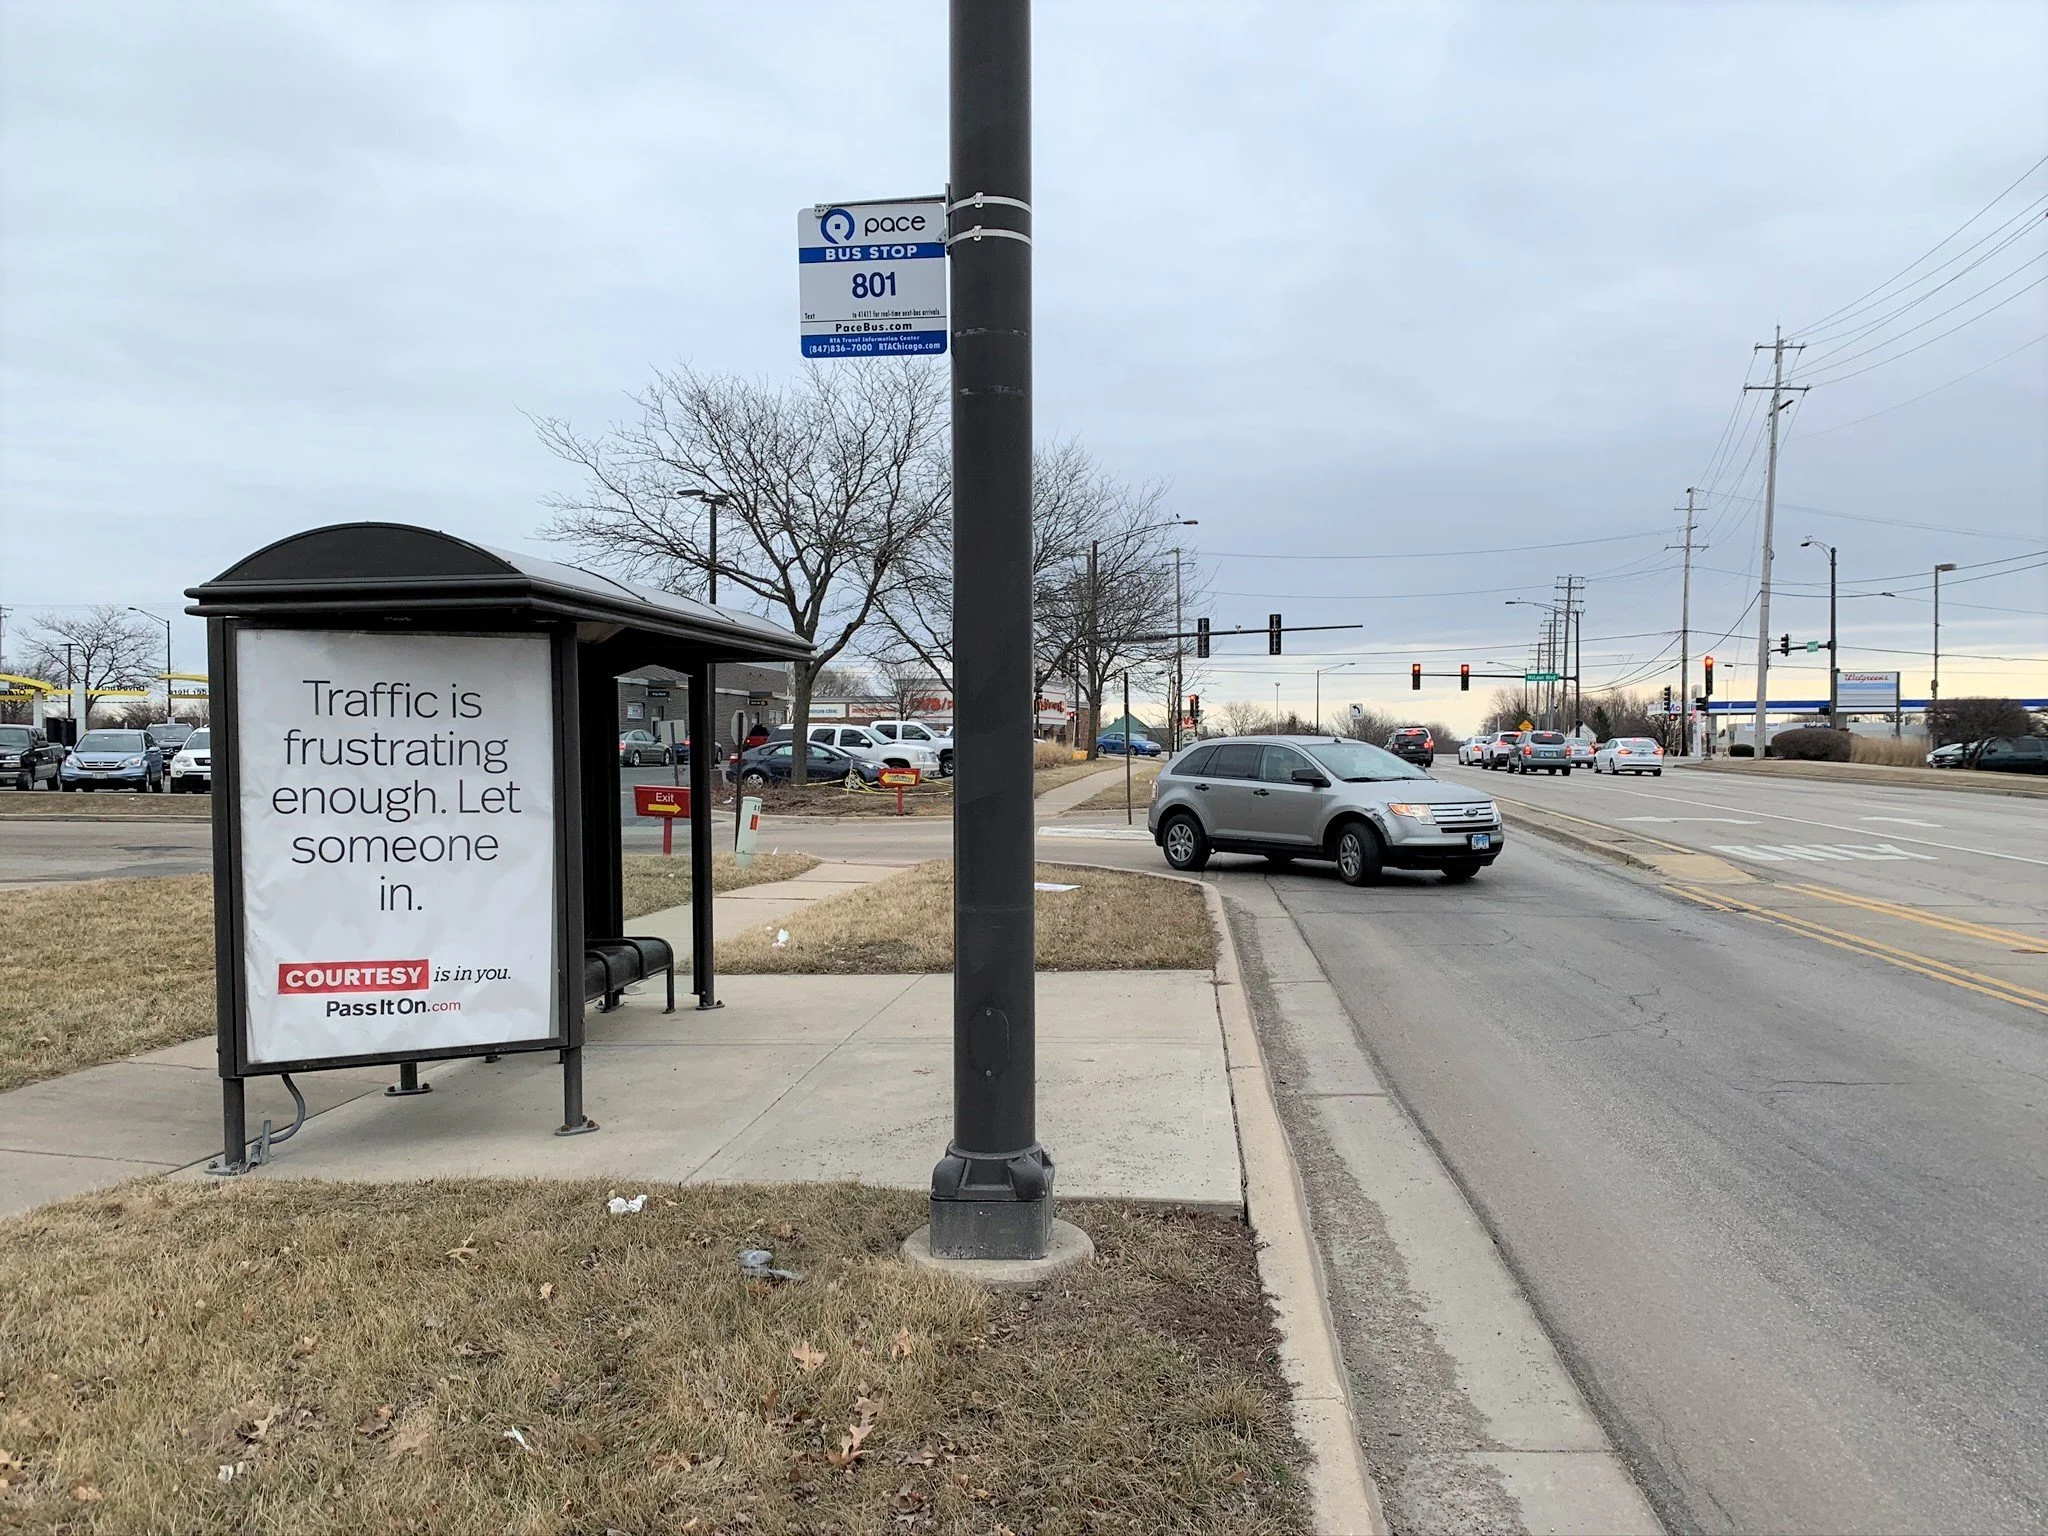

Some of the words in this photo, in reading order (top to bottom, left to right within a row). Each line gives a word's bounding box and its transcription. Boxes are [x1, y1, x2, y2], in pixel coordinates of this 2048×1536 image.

[864, 215, 926, 237] pace
[825, 247, 862, 261] BUS
[869, 245, 918, 259] STOP
[852, 271, 896, 299] 801
[804, 312, 816, 320] Text
[881, 309, 901, 317] real-time
[835, 322, 912, 332] PaceBus.com
[809, 343, 873, 355] (847)836-7000
[878, 342, 941, 351] RTAChicago.com
[1844, 673, 1890, 683] Walgreens
[302, 680, 439, 719] Traffic
[451, 683, 483, 719] is
[283, 728, 509, 775] frustrating
[271, 780, 448, 823] enough.
[458, 778, 523, 814] Let
[655, 792, 675, 803] Exit
[291, 834, 499, 864] someone
[379, 875, 423, 911] in.
[285, 966, 423, 988] COURTESY
[433, 966, 451, 982] is
[455, 965, 472, 982] in
[473, 966, 512, 984] you.
[326, 998, 461, 1018] PassItOn.com
